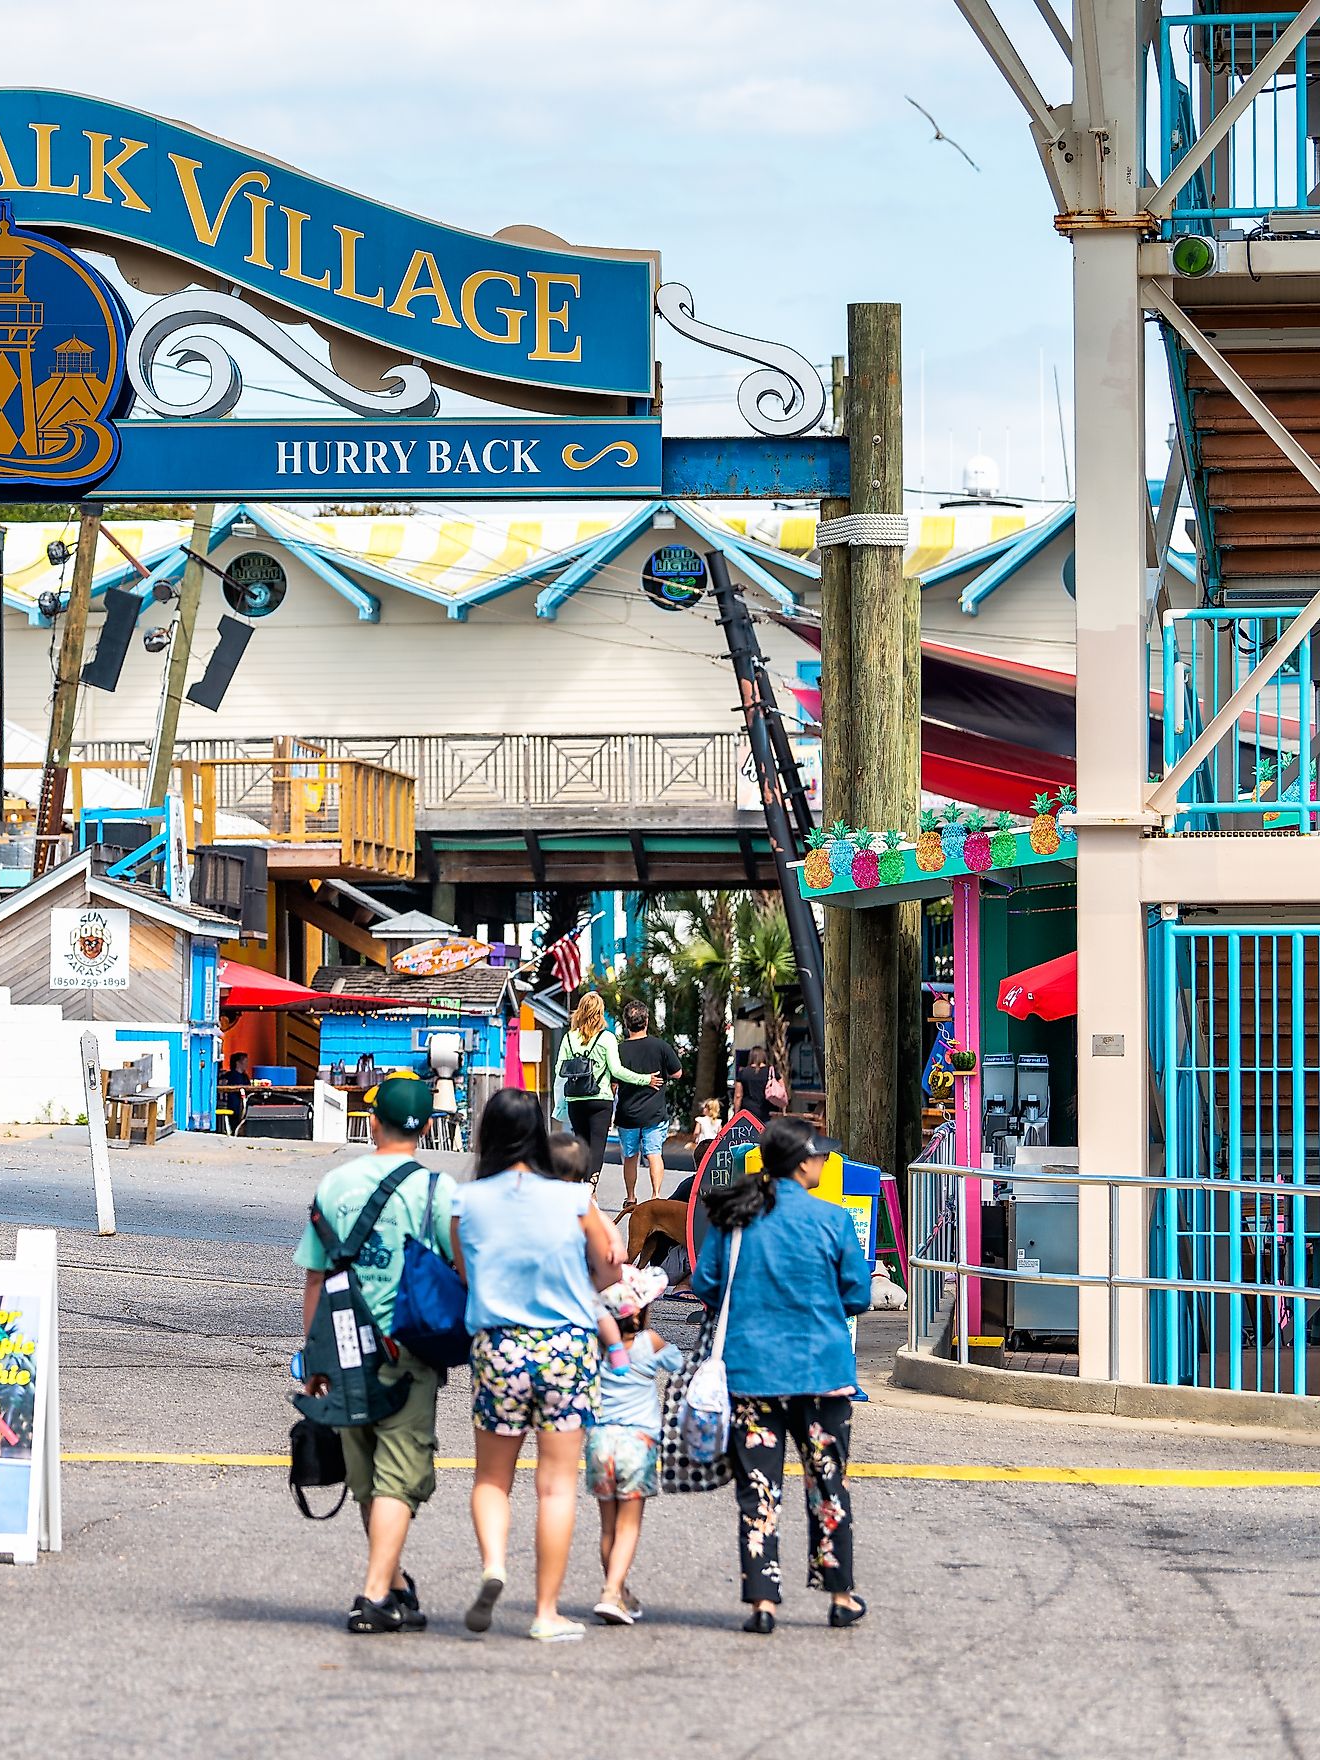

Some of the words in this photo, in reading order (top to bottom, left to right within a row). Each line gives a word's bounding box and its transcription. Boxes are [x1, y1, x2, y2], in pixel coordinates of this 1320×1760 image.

[167, 151, 584, 364] VILLAGE
[275, 440, 417, 475] HURRY
[426, 438, 542, 474] BACK
[662, 548, 694, 560] BUD
[656, 559, 700, 572] LIGHT
[80, 911, 108, 927] SUN
[69, 923, 112, 946] DOGS
[64, 953, 119, 977] PARASAIL
[729, 1125, 753, 1138] TRY
